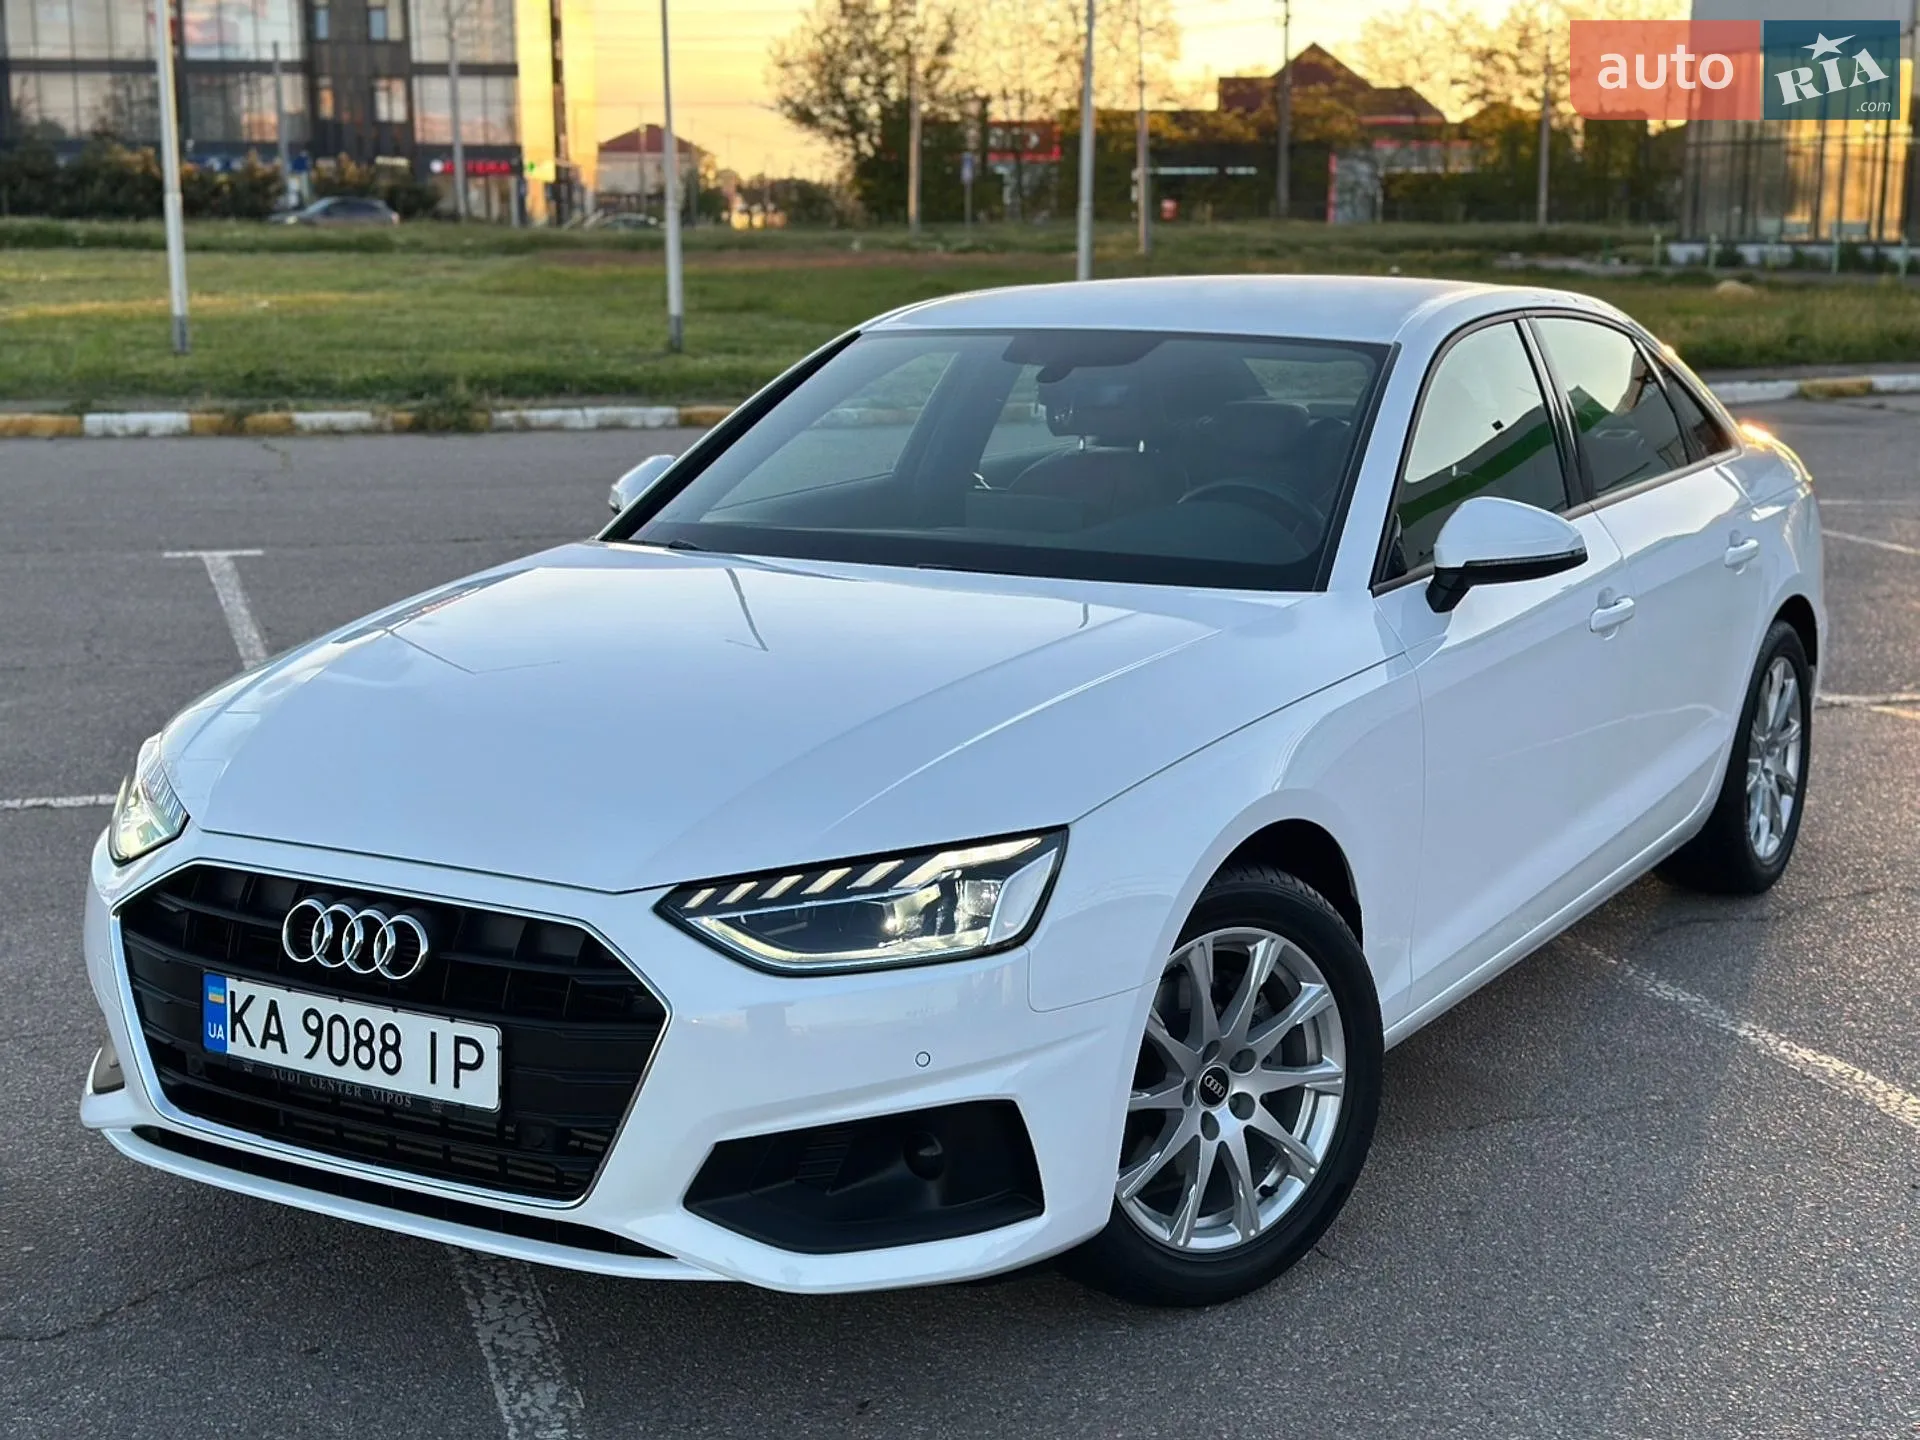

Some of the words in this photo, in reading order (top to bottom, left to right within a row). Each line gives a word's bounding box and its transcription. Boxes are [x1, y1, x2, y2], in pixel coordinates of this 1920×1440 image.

[208, 1022, 225, 1041] UA
[230, 990, 288, 1054] KA
[302, 1007, 402, 1076] 9088
[430, 1031, 485, 1089] IP
[270, 1069, 300, 1085] AUDI
[309, 1077, 362, 1097] CENTER
[371, 1089, 412, 1108] VIPOS
